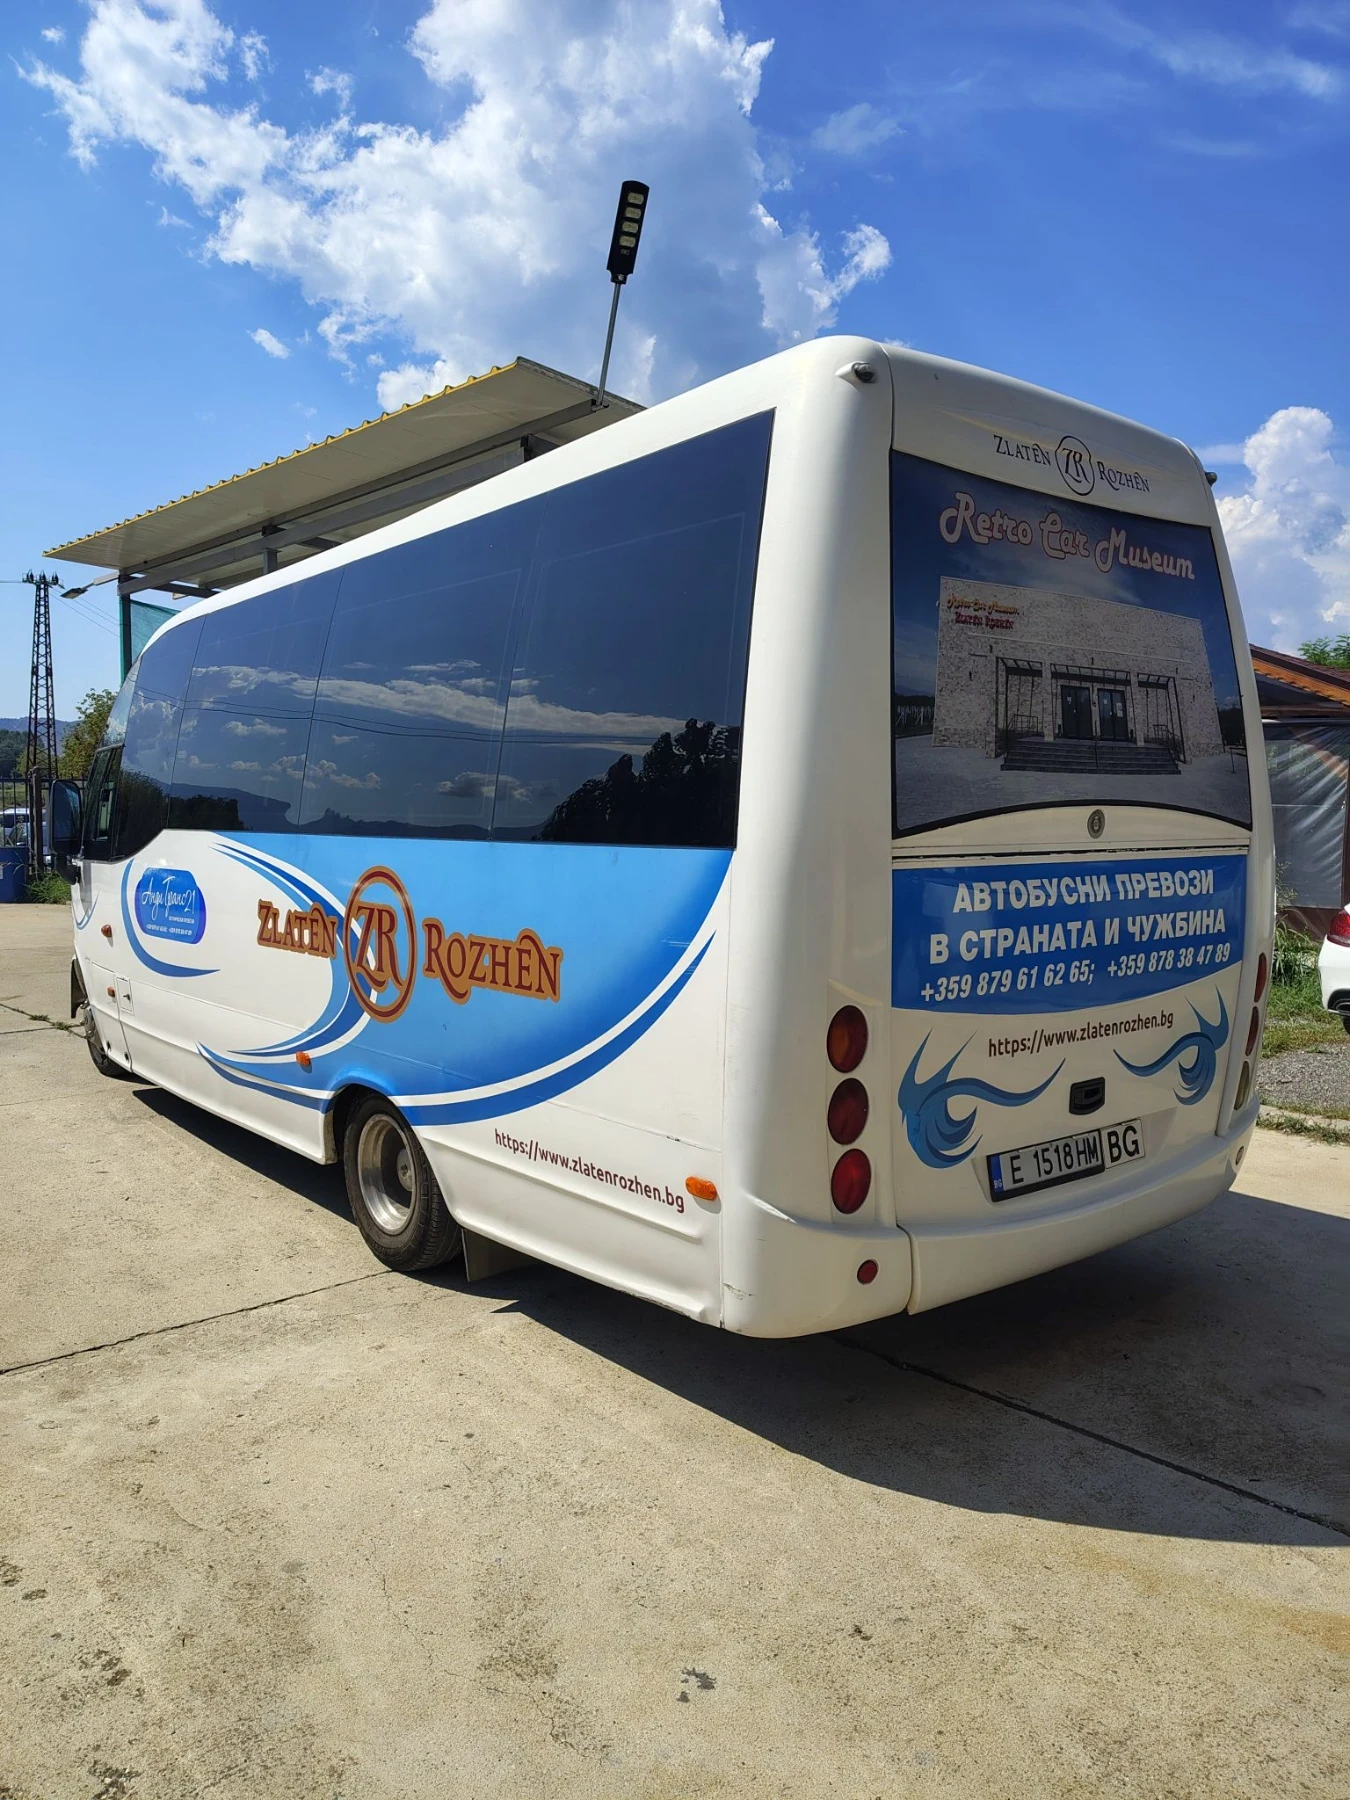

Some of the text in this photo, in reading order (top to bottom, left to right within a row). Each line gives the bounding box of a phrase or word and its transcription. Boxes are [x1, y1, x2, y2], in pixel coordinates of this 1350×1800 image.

[993, 434, 1150, 492] ZLATEN ZR ROZHEN
[939, 492, 1195, 580] Retro Car Museum
[953, 869, 1214, 913] АВТОБУСНИ ПРЕВОЗИ
[257, 901, 561, 1001] ZLATEN ZR ROZHEN
[929, 908, 1226, 964] В СТРАНАТА И ЧУЖБИНА
[921, 942, 1231, 1002] +359 879 61 62 65; +359 878 38 47 89
[989, 1010, 1174, 1057] https://www.zlatenrozhen.bg
[494, 1128, 685, 1214] https://www.zlatenrozhen.bg
[1010, 1154, 1024, 1184] E
[1107, 1125, 1140, 1163] BG
